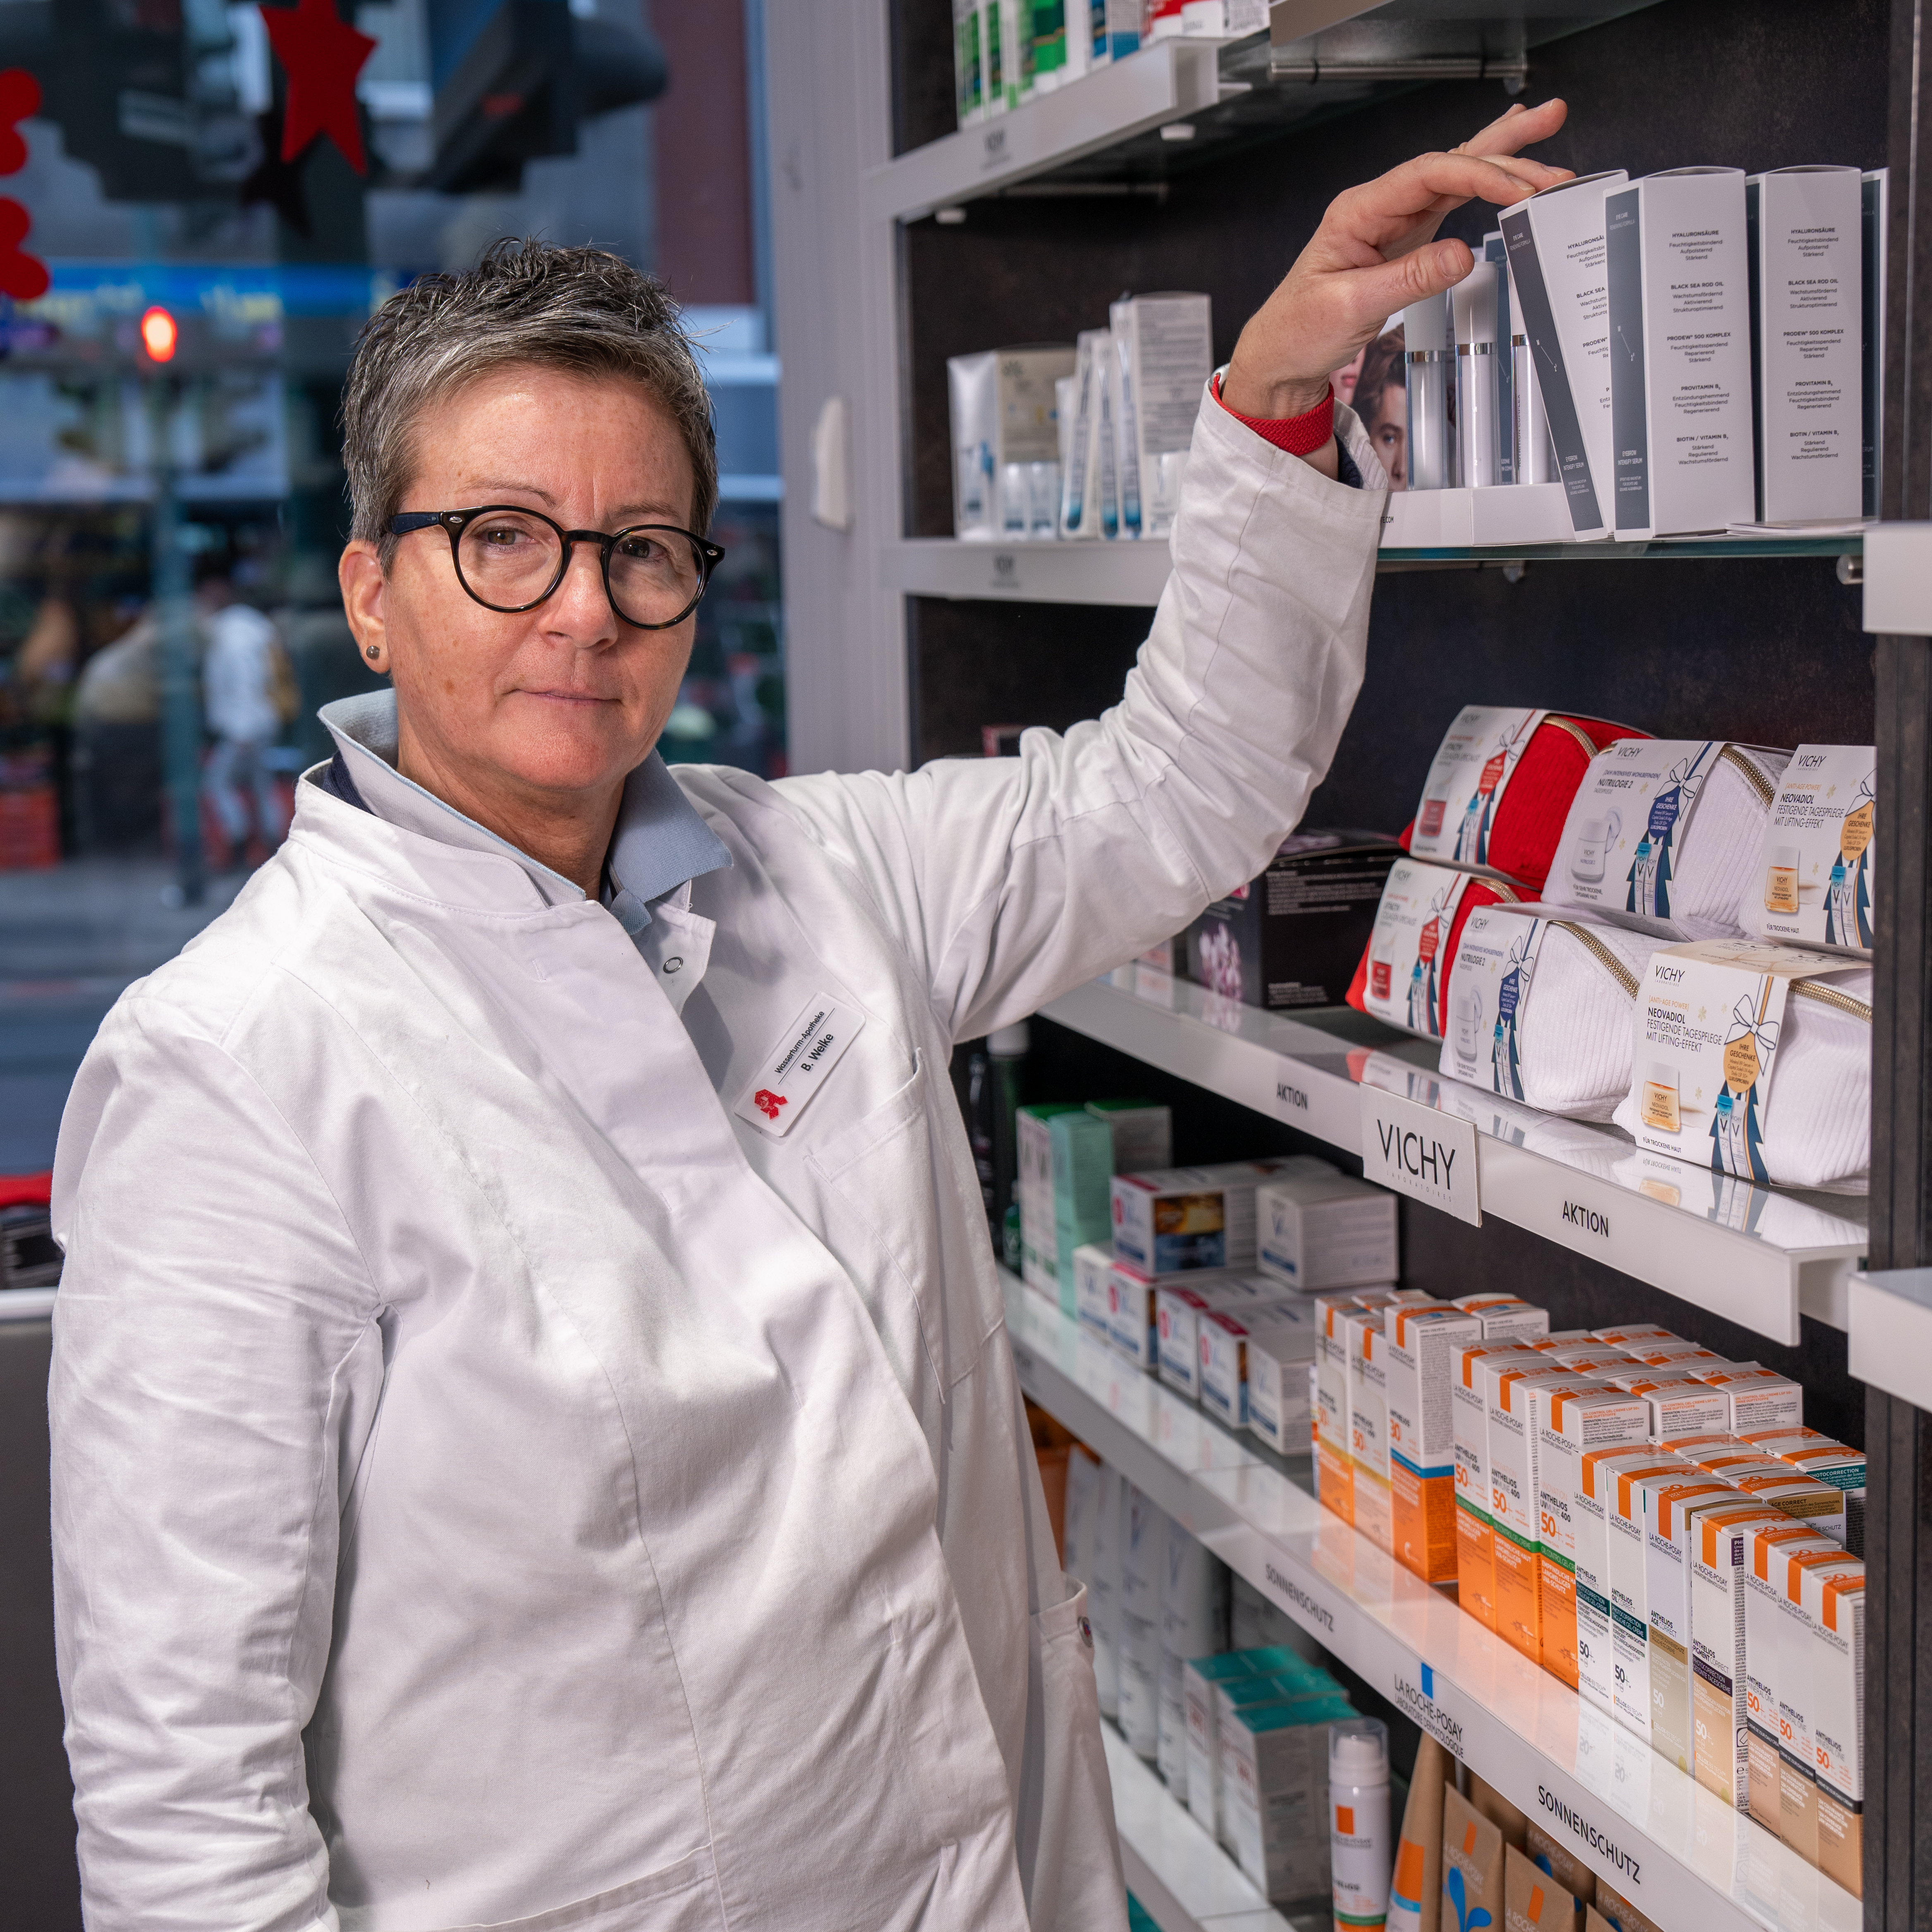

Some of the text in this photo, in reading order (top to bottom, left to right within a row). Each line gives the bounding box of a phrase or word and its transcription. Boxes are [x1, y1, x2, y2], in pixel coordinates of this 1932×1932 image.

[1669, 240, 1723, 248] Feuchtigkeitsbindend
[1673, 305, 1723, 313] Strukturoptimierend
[1671, 342, 1728, 350] Feuchtigkeitsspendend
[1673, 393, 1729, 401] Entzündungshemmend
[1616, 747, 1643, 757] VICHY
[1798, 755, 1827, 767] VICHY
[1597, 779, 1628, 788] NUTRILOGIE
[1780, 794, 1815, 804] NEOVADIOL
[1777, 805, 1844, 818] FESTIGENDE TAGESPFLEGE
[1774, 817, 1824, 828] MIT LIFTING-EFFEKT
[1471, 917, 1489, 930] VICHY
[1461, 953, 1482, 965] NUTRILOGIE
[1656, 965, 1685, 983] VICHY
[1648, 1007, 1685, 1024] NEOVADIOL
[1646, 1031, 1702, 1052] MIT LIFTING-EFFEKT
[1647, 1019, 1722, 1045] FESTIGENDE TAGESPFLEGE
[774, 1011, 825, 1074] Wasserturm-Apotheke
[801, 1033, 834, 1071] B. Welke
[1730, 1050, 1755, 1062] GESCHENKE
[1729, 1076, 1749, 1085] LUXUSPROBEN
[1277, 1082, 1308, 1110] AKTION
[1652, 1102, 1669, 1110] NEOVADIOL
[1655, 1093, 1667, 1101] VICHY
[1377, 1119, 1456, 1190] VICHY
[1650, 1139, 1671, 1150] TROCKENE
[1387, 1171, 1451, 1202] LABORATOIRES
[1562, 1200, 1608, 1237] AKTION
[1490, 1406, 1523, 1430] LA ROCHE-POSAY
[1491, 1468, 1517, 1489] ANTHELIOS
[1510, 1488, 1520, 1499] 400
[1540, 1491, 1567, 1511] ANTHELIOS
[1579, 1495, 1604, 1514] ROCHE-POSAY
[1561, 1511, 1571, 1522] 400
[1615, 1516, 1641, 1536] ROCHE-POSAY
[1655, 1536, 1681, 1557] ROCHE-POSAY
[1542, 1560, 1569, 1580] EMPFINDLICHE
[1542, 1568, 1570, 1590] LANGWELLIGER
[1576, 1565, 1596, 1582] ANTHELIOS
[1693, 1560, 1727, 1586] LA ROCHE-POSAY
[1542, 1575, 1566, 1594] UVA-SCHUTZ
[1582, 1576, 1599, 1590] CORRECT
[1265, 1563, 1334, 1633] SONNENSCHUTZ
[1577, 1583, 1604, 1605] PHOTOCORRECTION
[1612, 1588, 1632, 1605] ANTHELIOS
[1618, 1598, 1635, 1614] CORRECT
[1778, 1595, 1811, 1621] LA ROCHE-POSAY
[1612, 1605, 1641, 1628] PHOTOCORRECTION
[1651, 1609, 1673, 1628] ANTHELIOS
[1659, 1622, 1676, 1638] CORRECT
[1693, 1638, 1715, 1658] ANTHELIOS
[1693, 1645, 1729, 1674] PIGMENT CORRECT
[1693, 1657, 1725, 1683] PHOTOCORRECTION
[1707, 1674, 1731, 1694] TAGESCREME
[1747, 1674, 1771, 1695] ANTHELIOS
[1747, 1681, 1774, 1705] MINERAL ONE
[1653, 1688, 1664, 1707] 50
[1394, 1674, 1462, 1742] LA ROCHE-POSAY
[1779, 1701, 1803, 1722] ANTHELIOS
[1395, 1693, 1463, 1758] LABORATOIRE DERMATOLOGIQUE
[1779, 1708, 1806, 1732] MINERAL ONE
[1815, 1729, 1841, 1751] ANTHELIOS
[1815, 1737, 1844, 1762] MINERAL ONE
[1786, 1772, 1805, 1790] COUVRANCE
[1538, 1785, 1640, 1884] SONNENSCHUTZ
